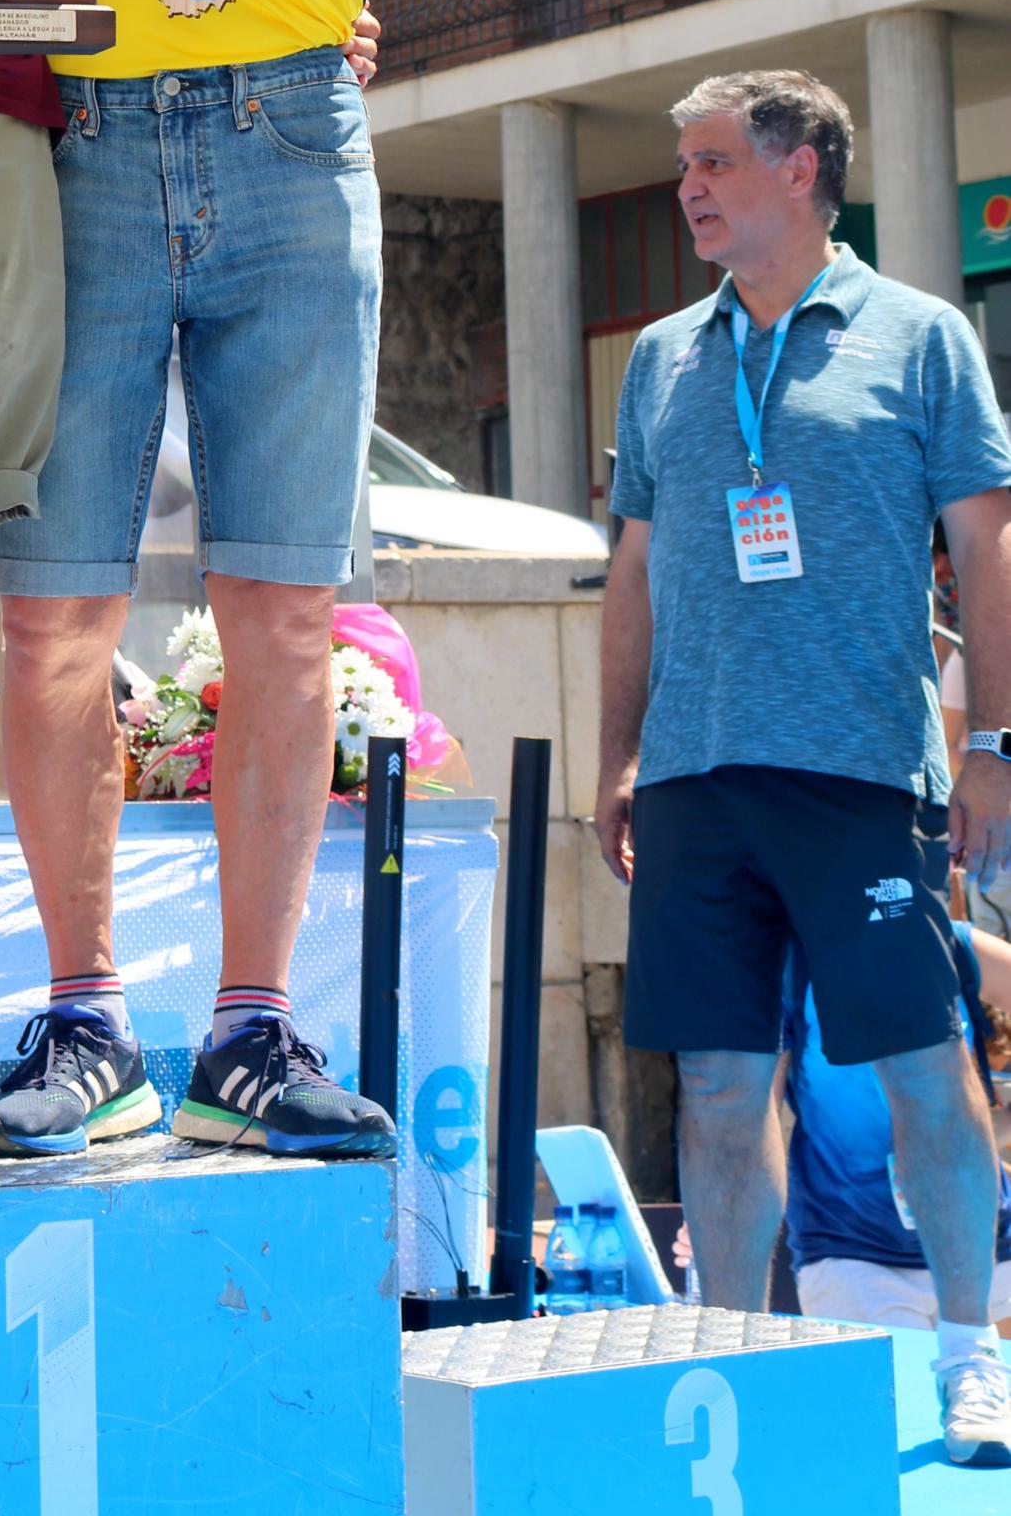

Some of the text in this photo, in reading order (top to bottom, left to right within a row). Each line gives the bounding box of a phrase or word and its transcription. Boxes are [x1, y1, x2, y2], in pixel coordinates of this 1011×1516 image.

[878, 878, 896, 888] THE
[865, 886, 896, 897] NORTH
[875, 893, 896, 903] FACE
[6, 1219, 98, 1516] 1
[664, 1367, 745, 1516] 3
